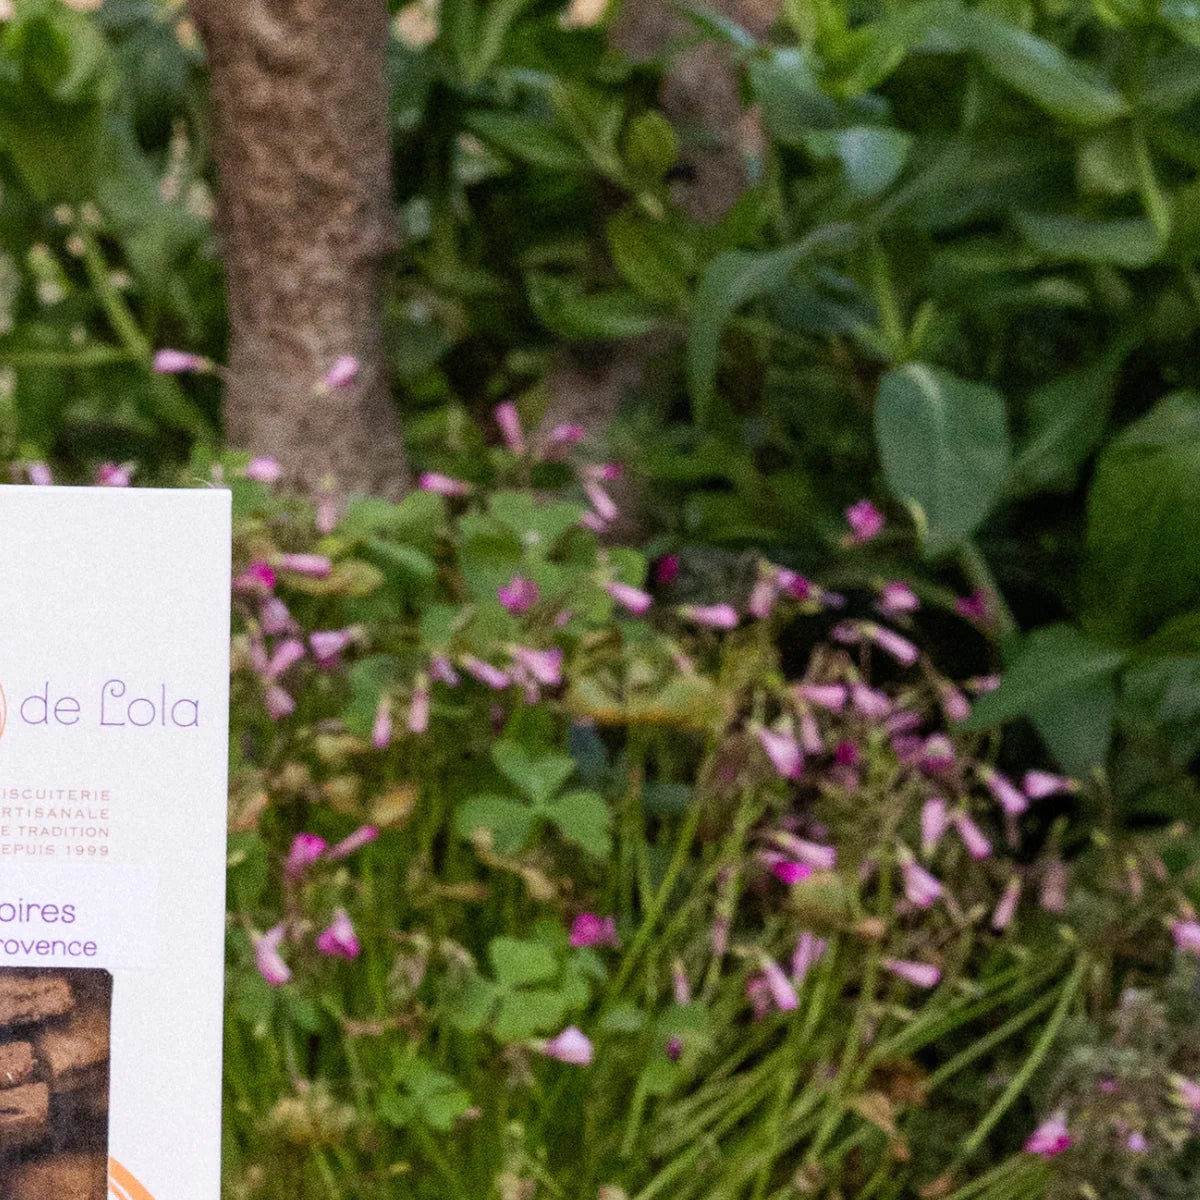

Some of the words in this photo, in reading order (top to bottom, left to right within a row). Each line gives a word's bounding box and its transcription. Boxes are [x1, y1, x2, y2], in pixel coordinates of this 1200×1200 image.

[20, 681, 81, 725] de
[100, 679, 200, 727] Lola
[18, 826, 109, 837] TRADITION
[66, 845, 109, 856] 1999
